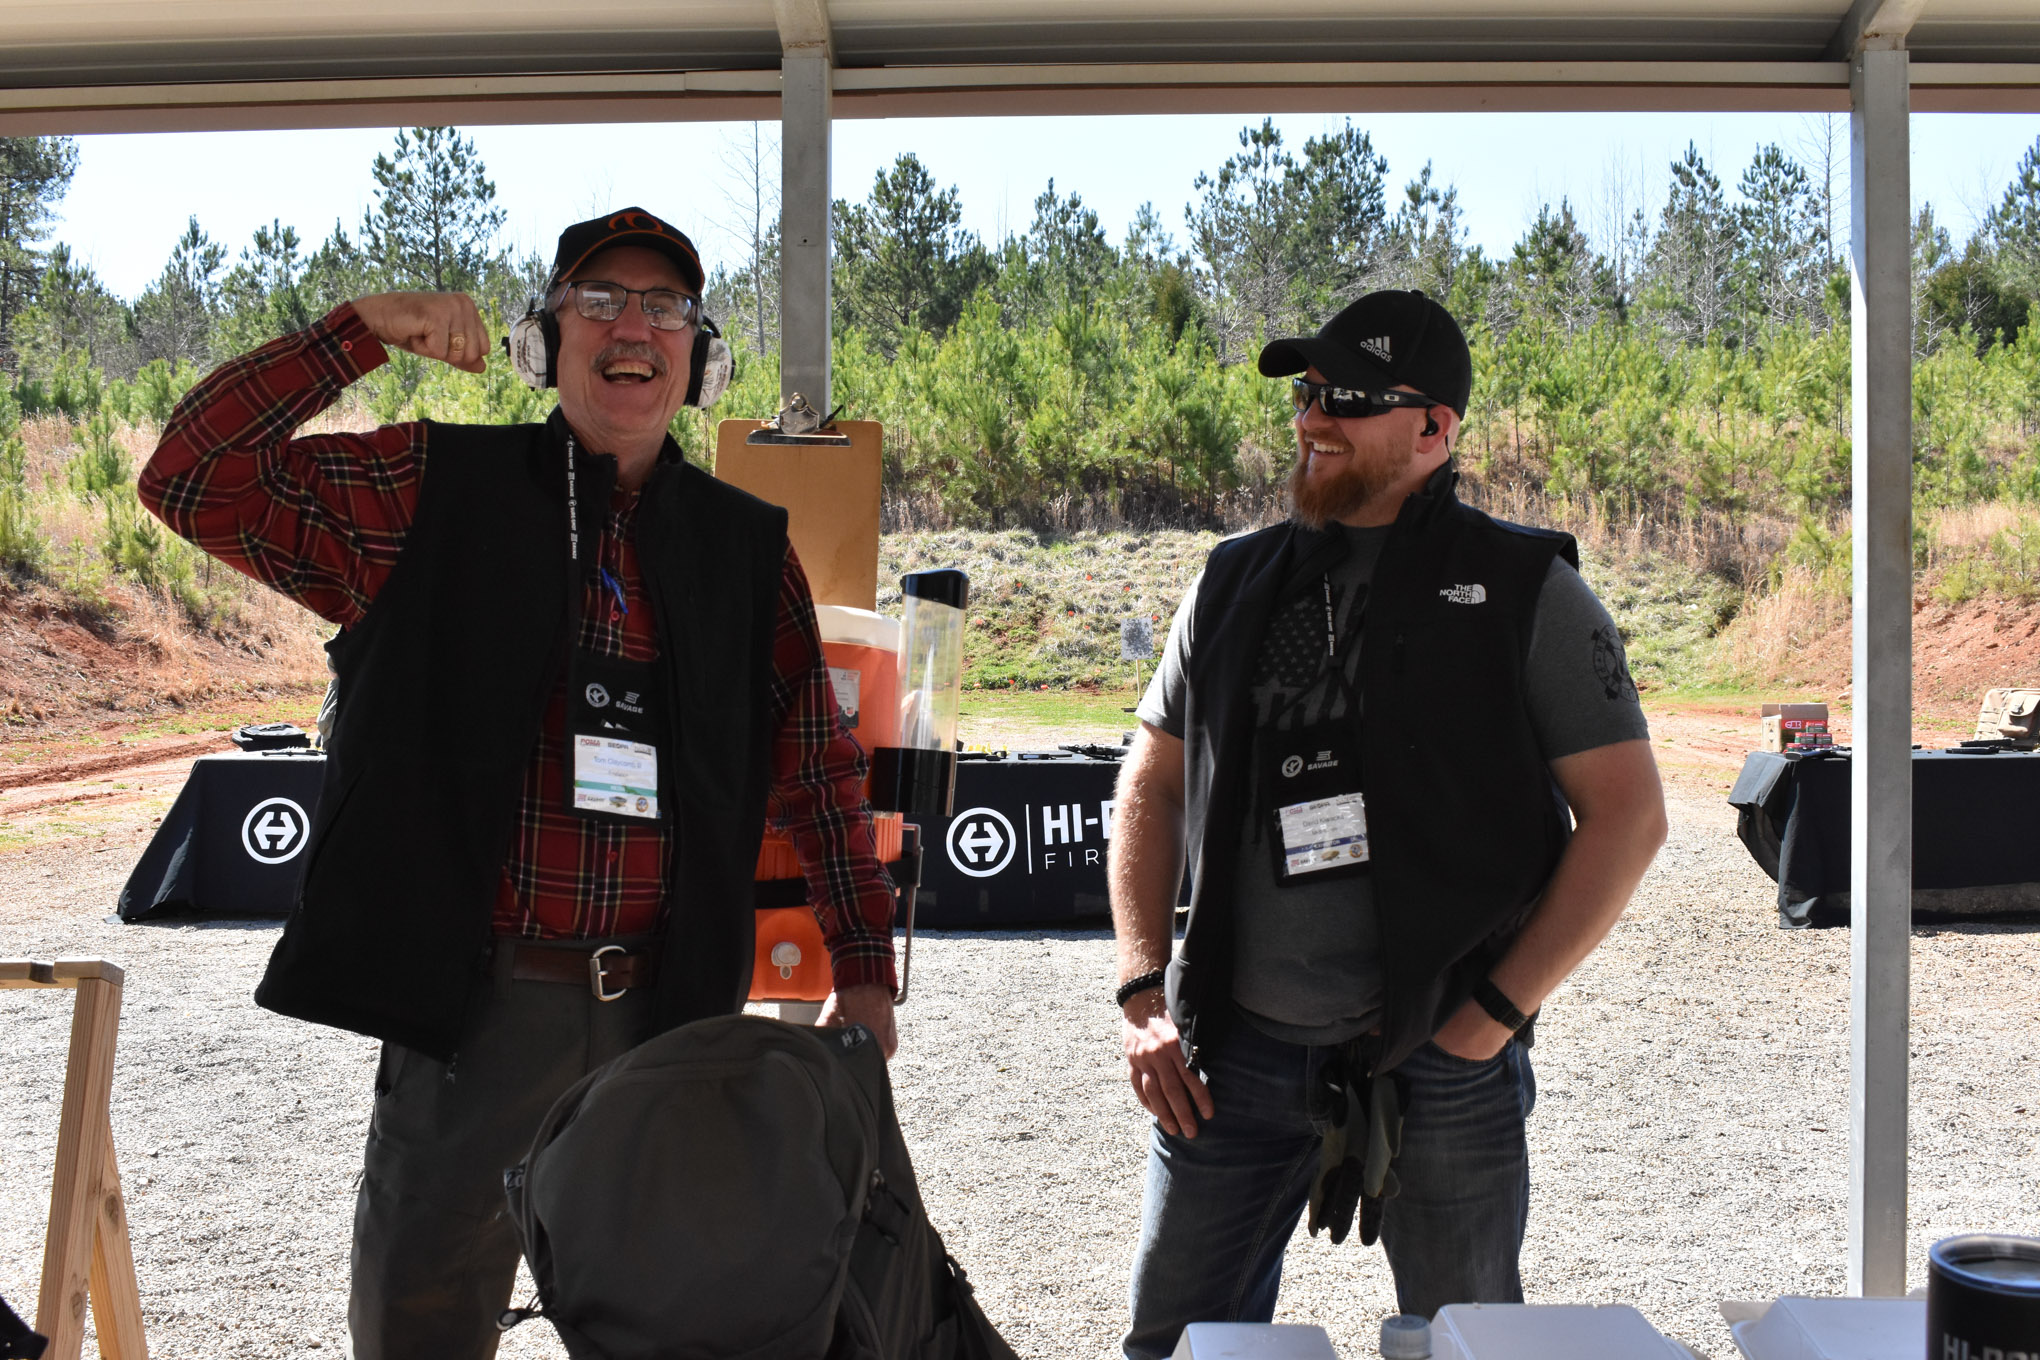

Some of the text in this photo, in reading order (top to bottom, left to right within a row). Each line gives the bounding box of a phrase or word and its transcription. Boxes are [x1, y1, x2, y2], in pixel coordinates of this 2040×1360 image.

[1360, 340, 1393, 363] adidas
[1439, 589, 1472, 598] NORTH
[1447, 595, 1472, 604] FACE
[615, 701, 644, 714] SAVAGE
[1307, 760, 1339, 771] SAVAGE
